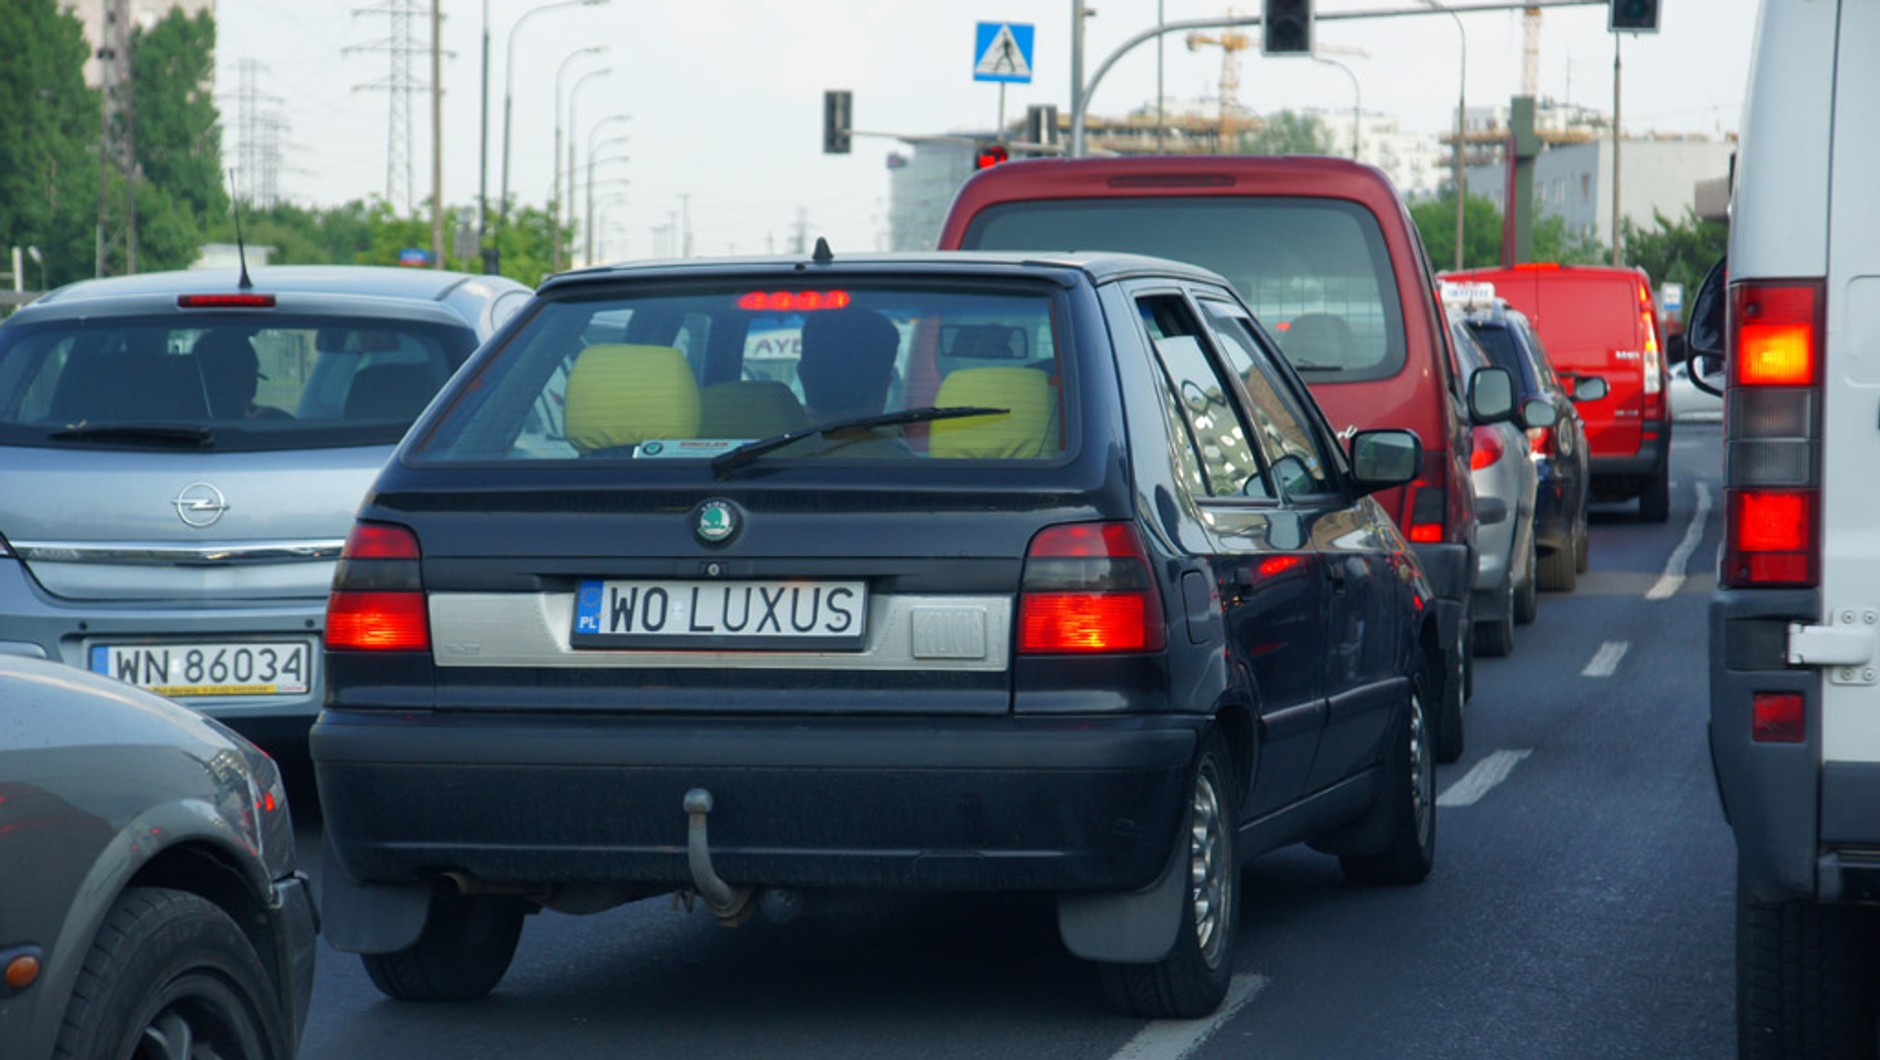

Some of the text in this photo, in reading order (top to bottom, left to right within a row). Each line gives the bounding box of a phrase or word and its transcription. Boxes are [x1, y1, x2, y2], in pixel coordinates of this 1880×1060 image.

[580, 616, 597, 629] PL
[689, 587, 854, 632] LUXUS
[116, 648, 301, 684] WN 86034
